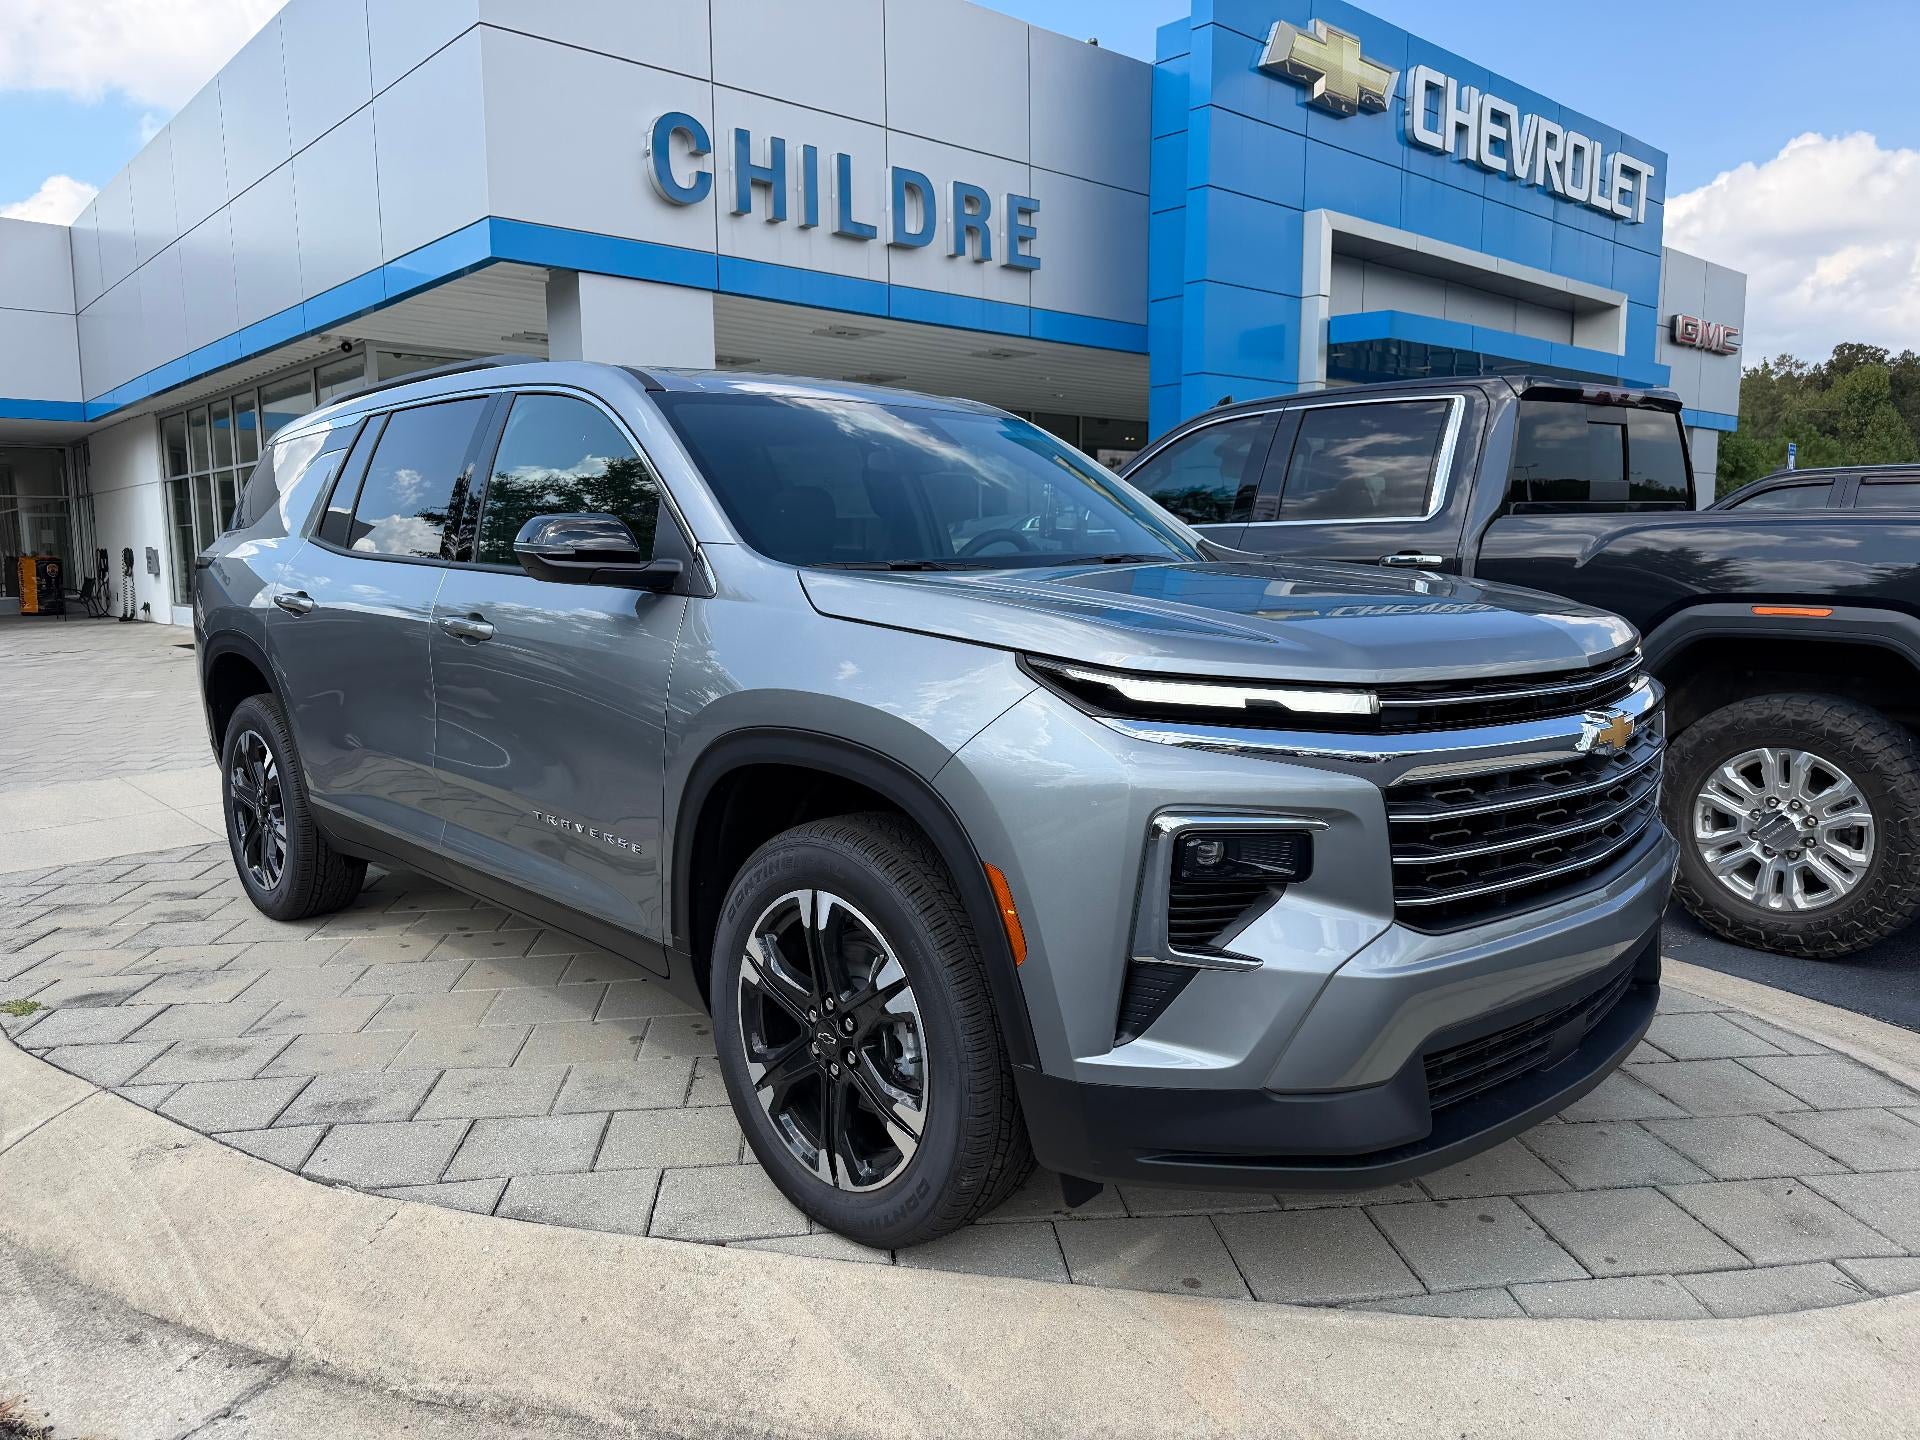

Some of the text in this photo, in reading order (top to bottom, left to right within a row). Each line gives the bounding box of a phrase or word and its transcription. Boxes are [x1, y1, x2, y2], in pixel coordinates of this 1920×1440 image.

[646, 112, 1041, 271] CHILDRE
[1407, 64, 1655, 224] CHEVROLET
[1673, 313, 1741, 355] GMC
[532, 810, 642, 855] TRAVERSE
